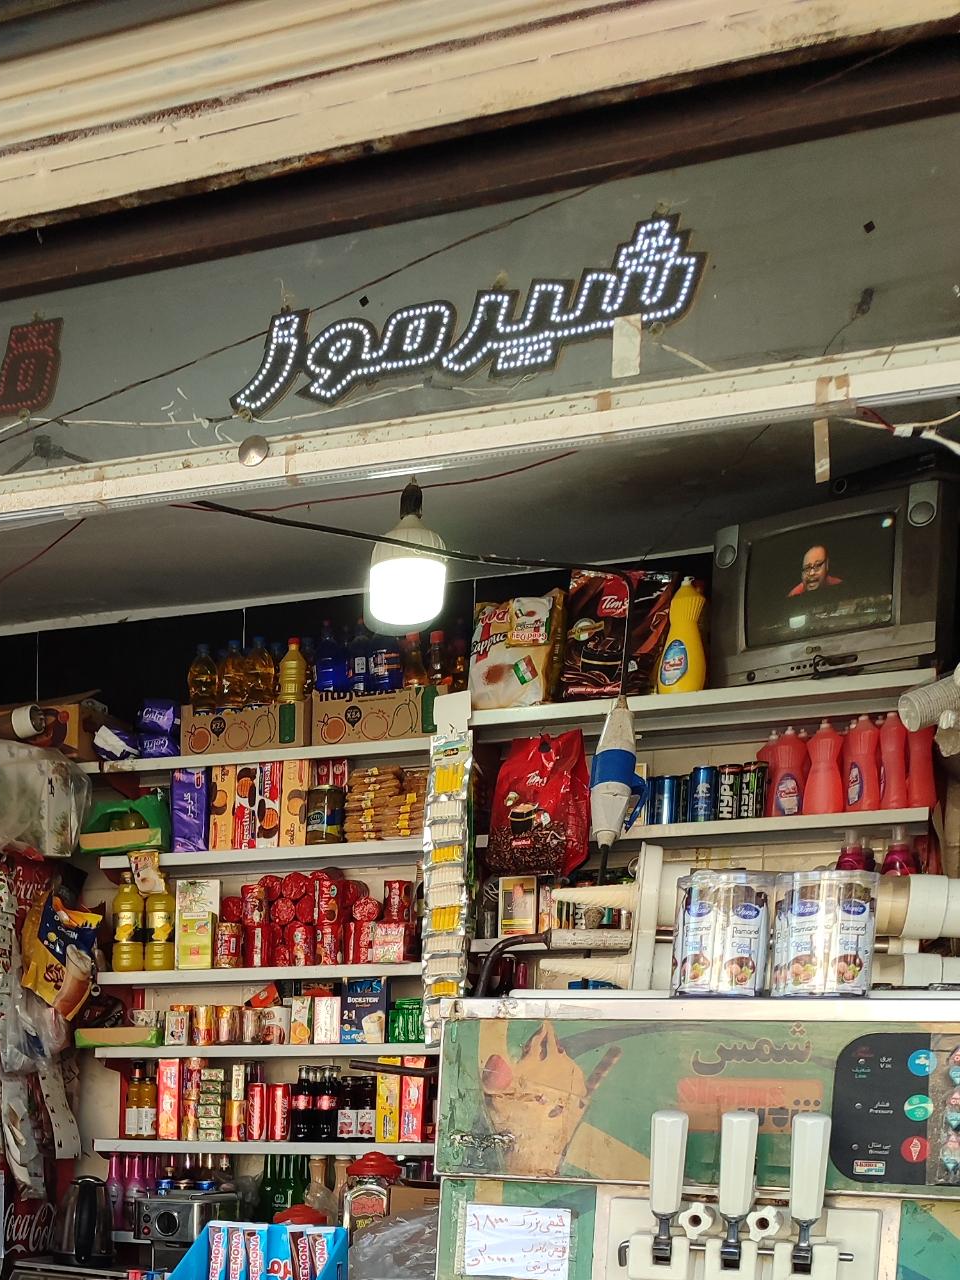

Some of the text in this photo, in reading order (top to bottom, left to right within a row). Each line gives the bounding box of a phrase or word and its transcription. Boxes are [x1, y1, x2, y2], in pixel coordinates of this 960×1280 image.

[471, 631, 507, 654] Cappuc
[720, 774, 734, 819] HYPE
[691, 1022, 813, 1076] شمس
